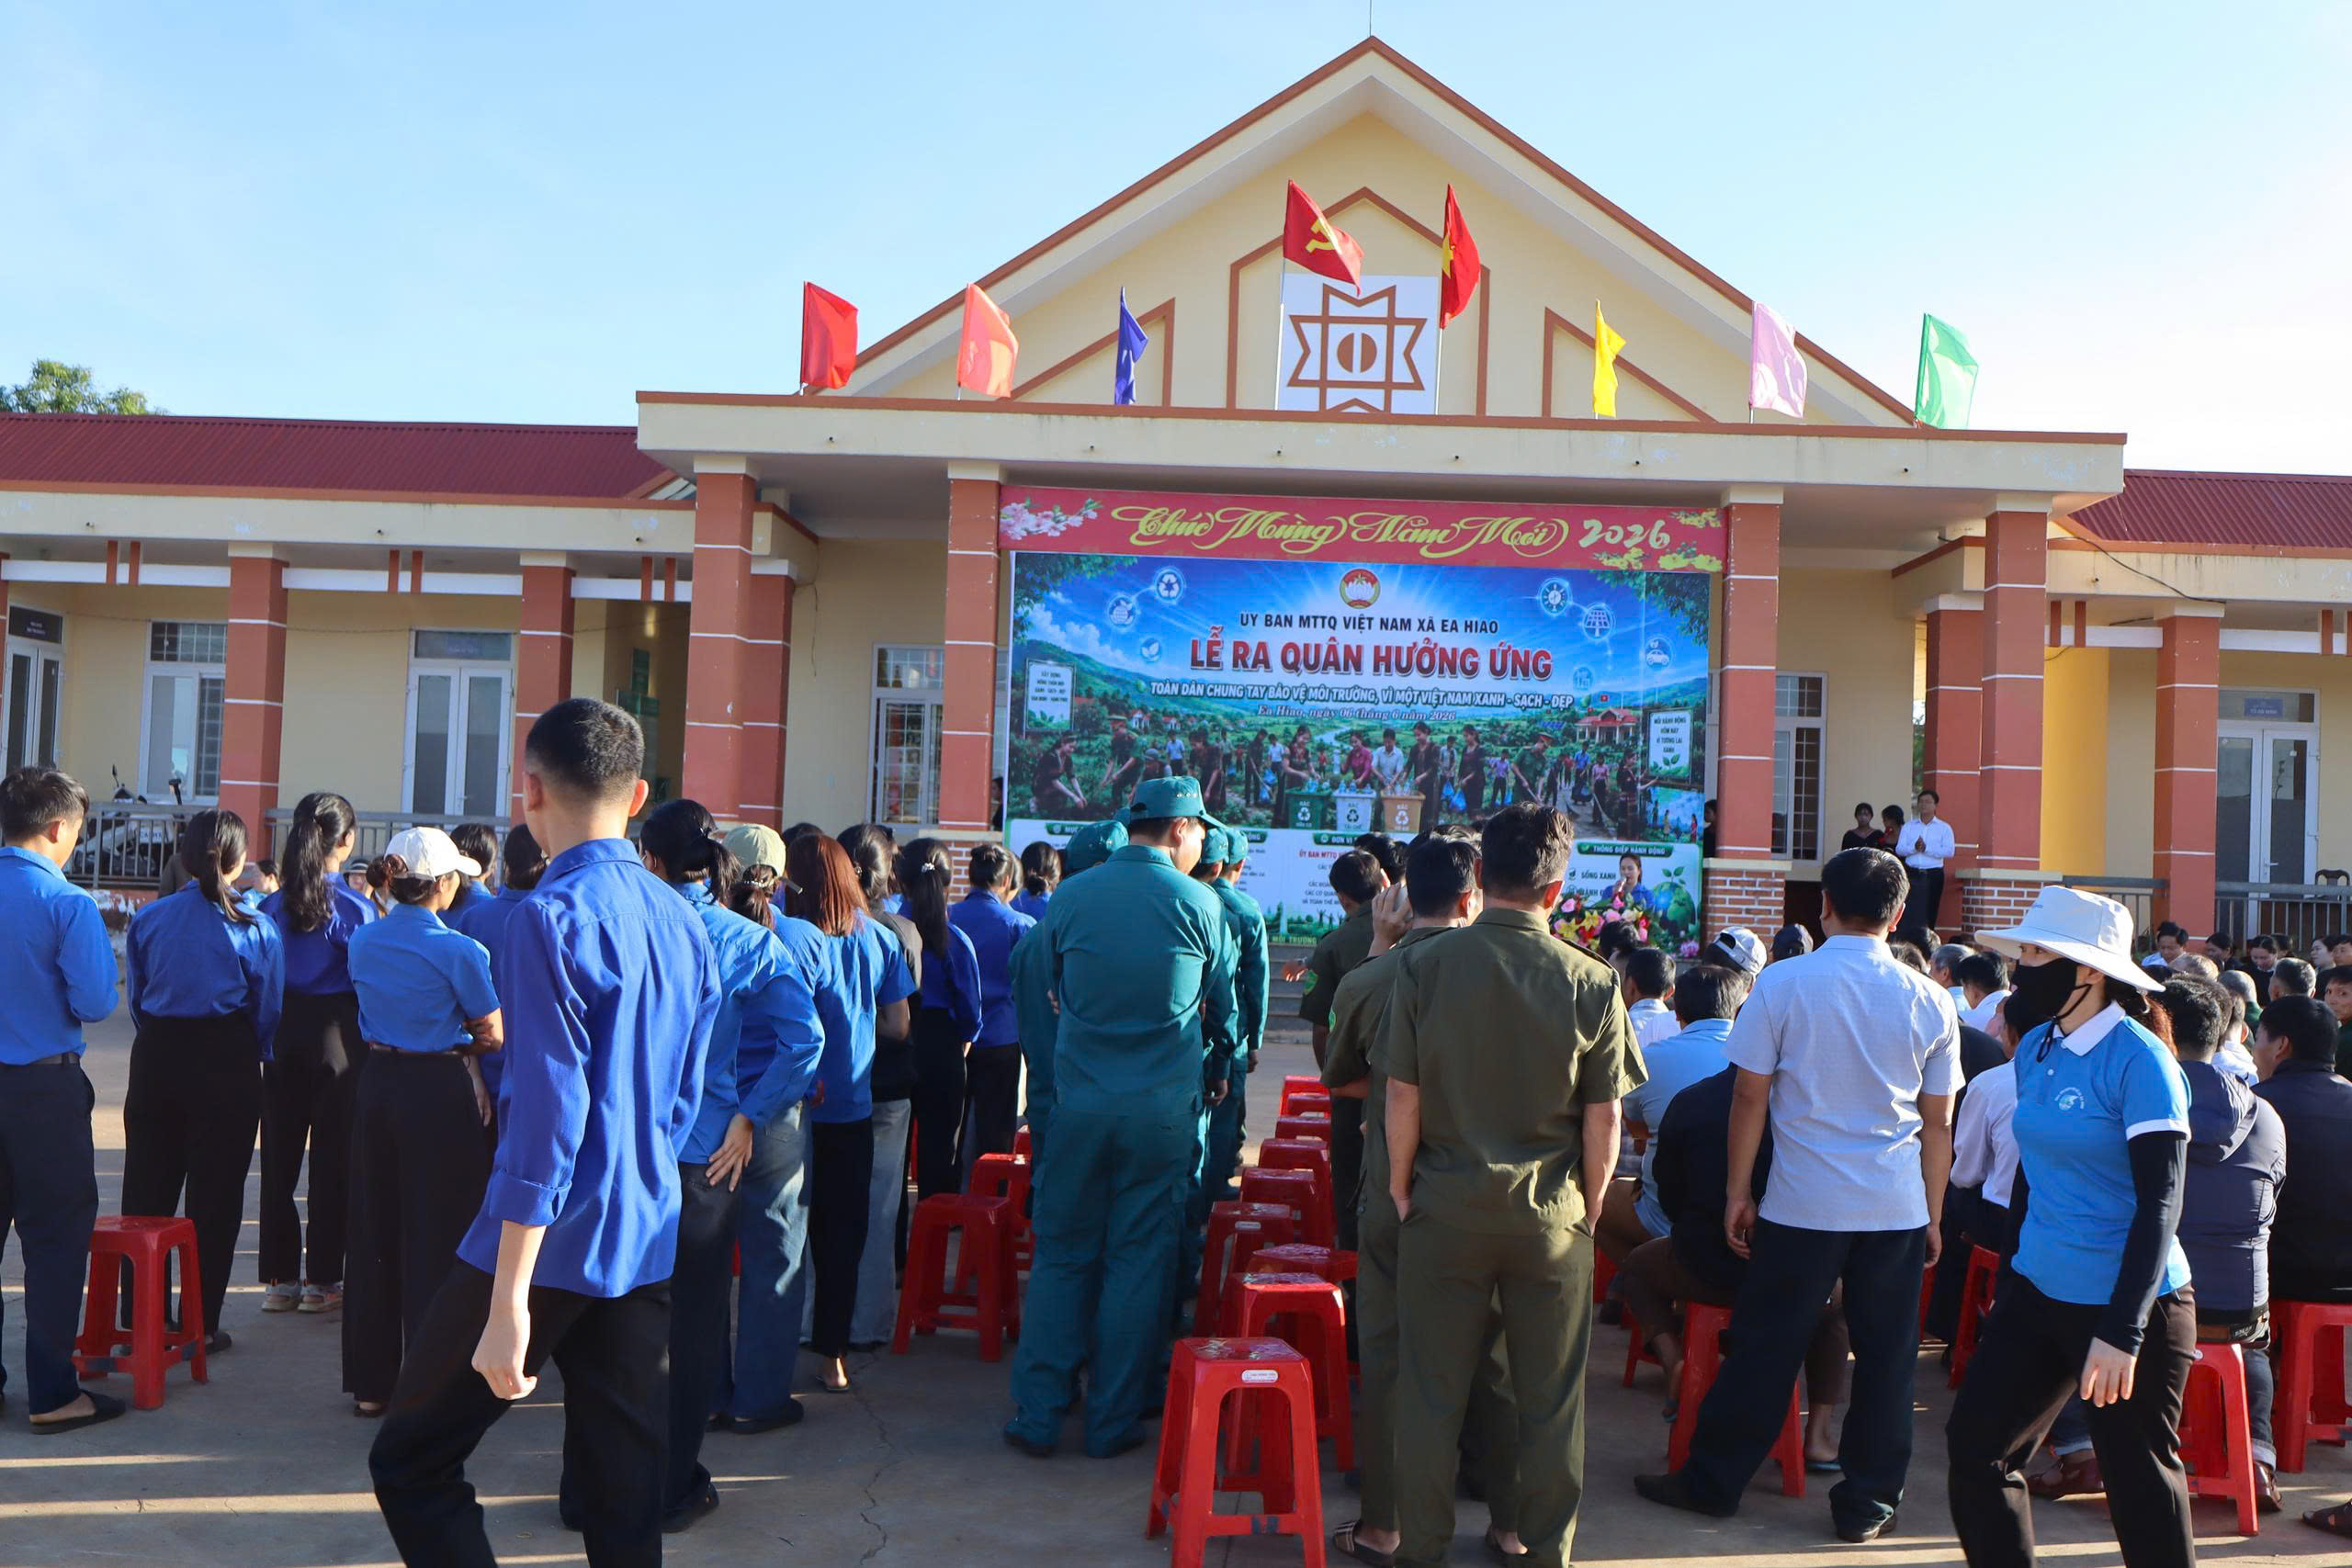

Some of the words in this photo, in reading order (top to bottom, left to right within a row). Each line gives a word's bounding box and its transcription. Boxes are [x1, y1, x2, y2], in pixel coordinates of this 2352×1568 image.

[1111, 505, 1215, 547] Chúc
[1192, 506, 1348, 554] Mừng
[1348, 511, 1461, 546] Năm
[1419, 515, 1569, 558] Mới
[1578, 519, 1670, 549] 2026
[1263, 614, 1293, 628] BAN
[1298, 615, 1338, 629] MTTQ
[1342, 614, 1374, 634] VIỆT
[1379, 617, 1412, 632] NAM
[1416, 615, 1435, 633] XÃ
[1441, 619, 1459, 633] EA
[1464, 620, 1498, 634] HIAO
[1190, 625, 1224, 671] LỄ
[1231, 640, 1272, 672] RA
[1280, 636, 1364, 676] QUÂN
[1372, 637, 1481, 678] HƯỞNG
[1488, 640, 1554, 681] ỨNG
[1150, 680, 1180, 695] TOÀN
[1181, 680, 1205, 697] DÂN
[1206, 684, 1245, 698] CHUNG
[1246, 685, 1266, 699] TAY
[1268, 682, 1290, 700] BẢO
[1292, 683, 1307, 704] VỆ
[1308, 684, 1329, 702] MÔI
[1382, 686, 1394, 704] VÌ
[1396, 687, 1419, 707] MỘT
[1420, 688, 1445, 708] VIỆT
[1447, 691, 1473, 705] NAM
[1474, 693, 1506, 706] XANH
[1514, 694, 1544, 710] SẠCH
[1551, 694, 1574, 711] ĐẸP
